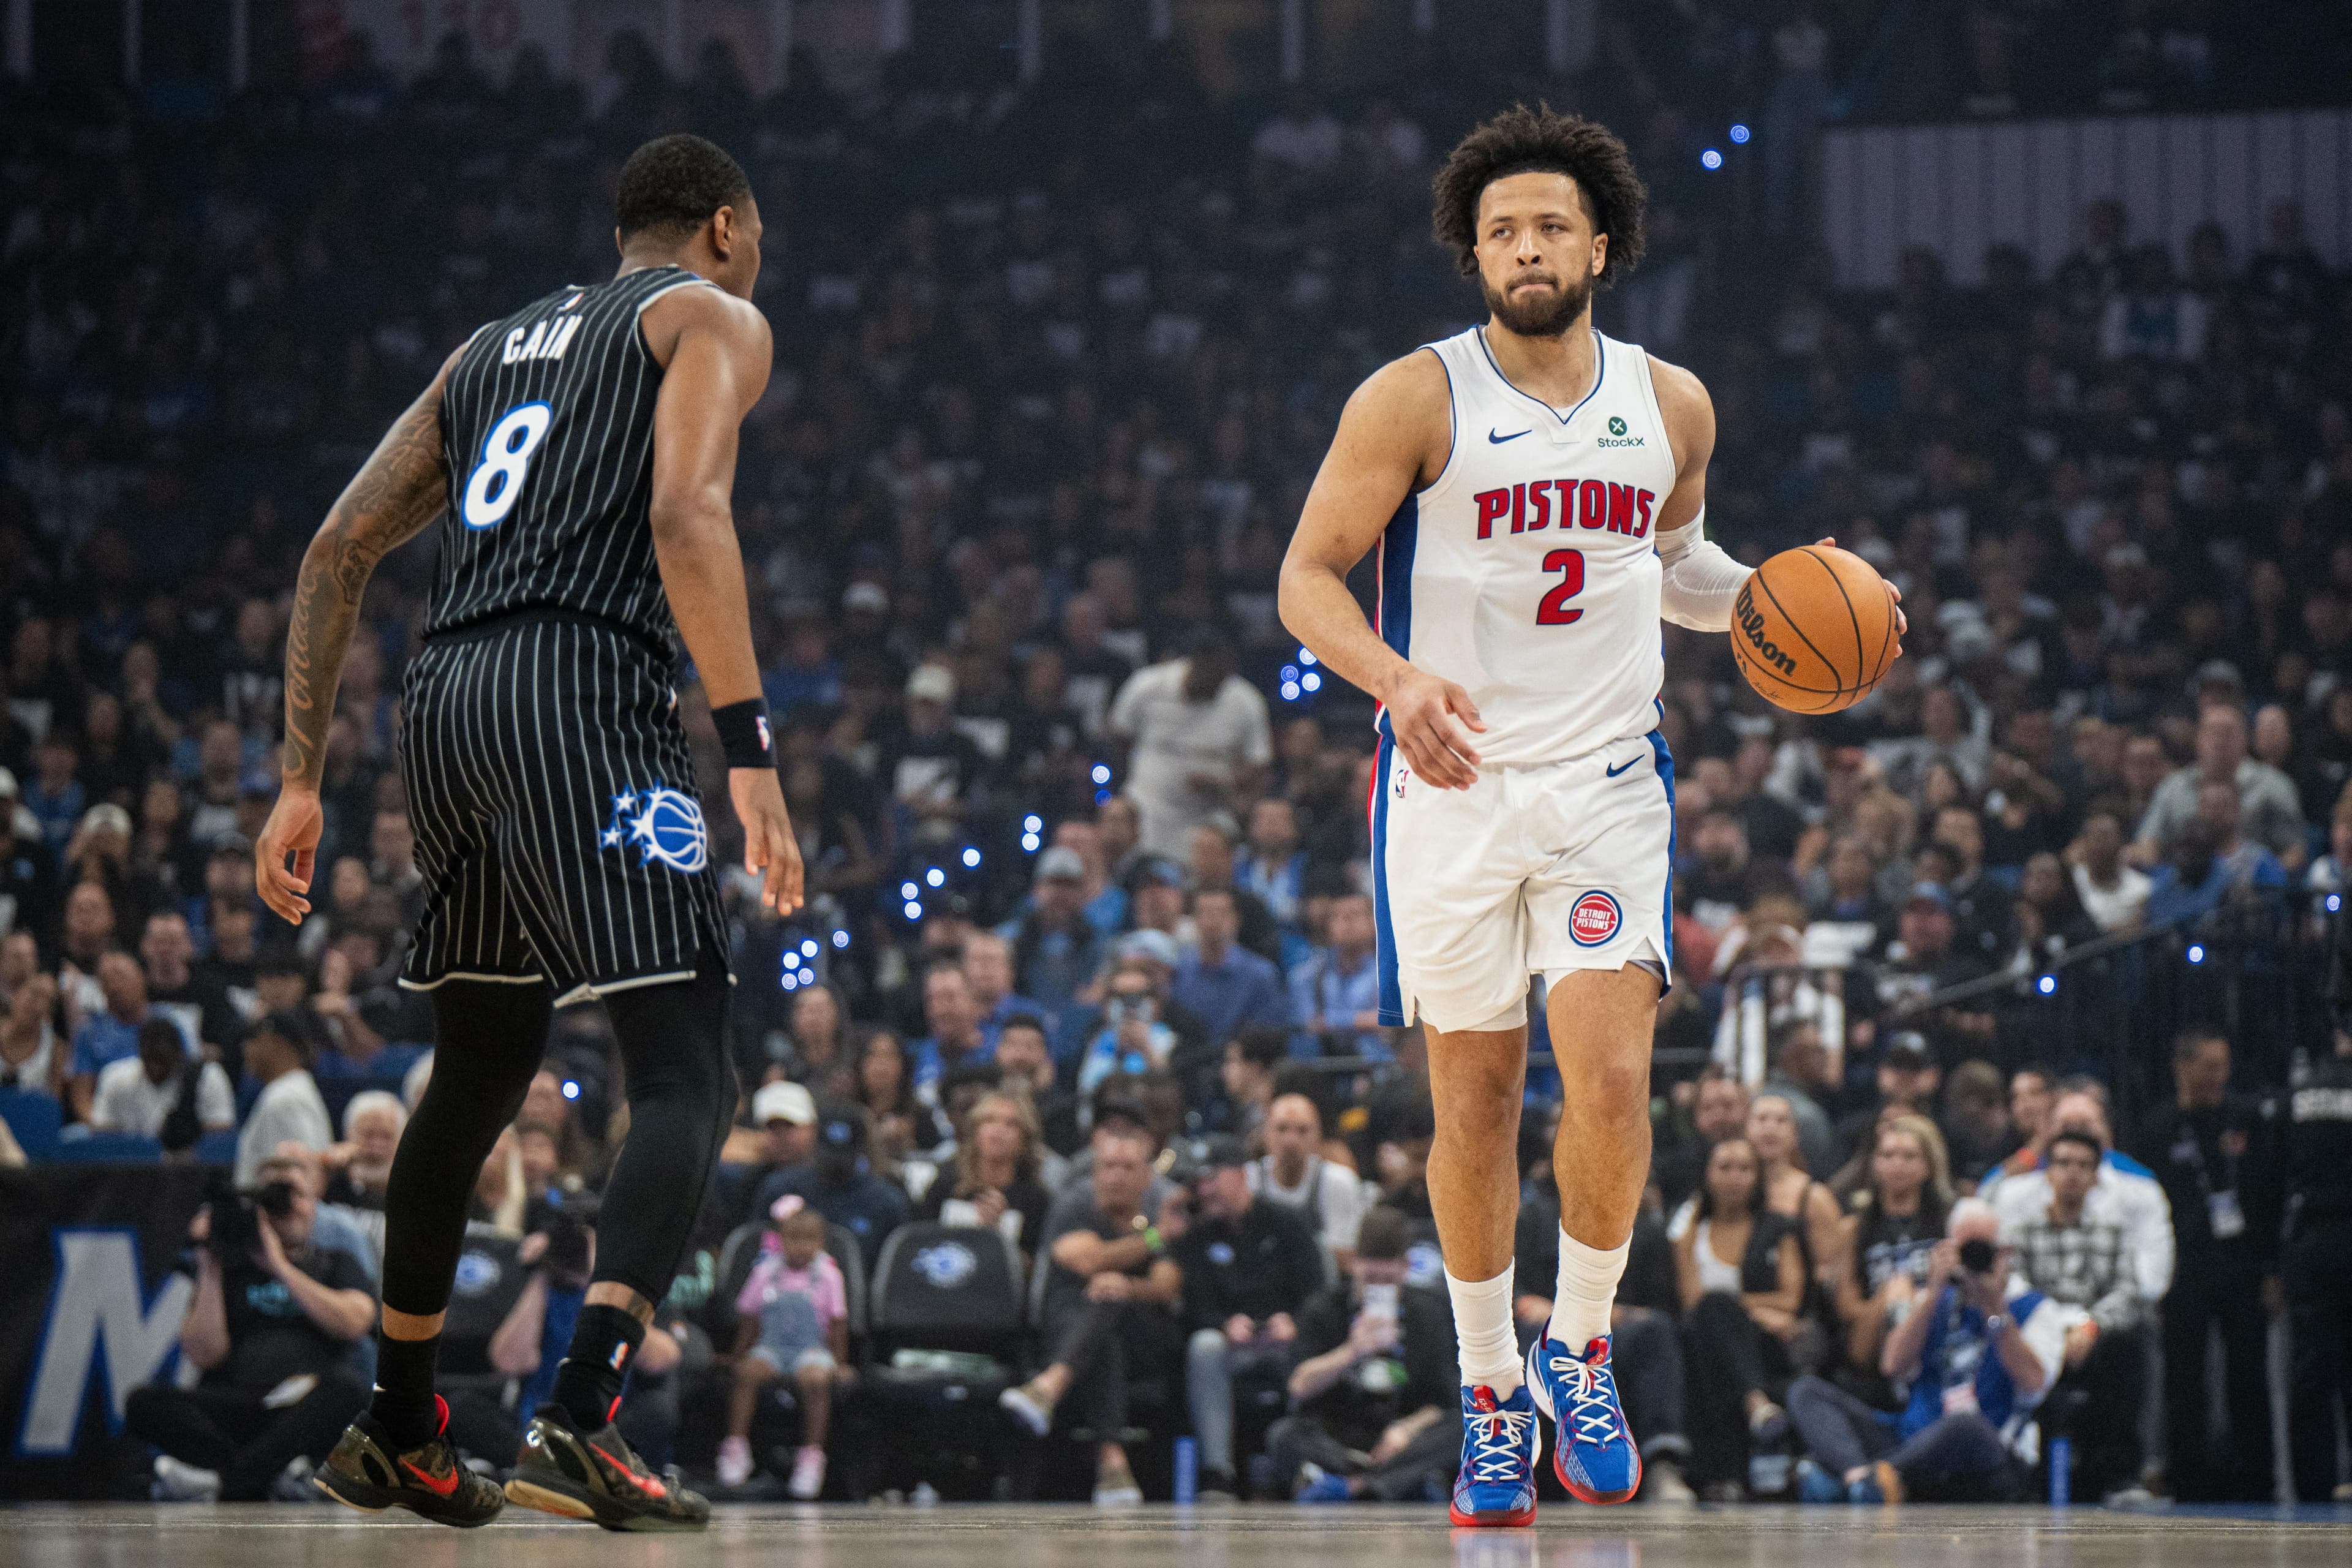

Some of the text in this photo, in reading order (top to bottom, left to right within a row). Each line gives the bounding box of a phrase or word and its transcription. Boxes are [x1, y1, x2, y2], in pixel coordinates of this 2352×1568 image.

[502, 314, 583, 365] CAIN
[462, 400, 552, 530] 8
[1597, 437, 1645, 448] StockX
[1473, 479, 1656, 540] PISTONS
[1536, 548, 1585, 626] 2
[1736, 581, 1796, 677] Wilson
[1577, 918, 1609, 930] PISTONS
[1579, 908, 1611, 921] DETROIT
